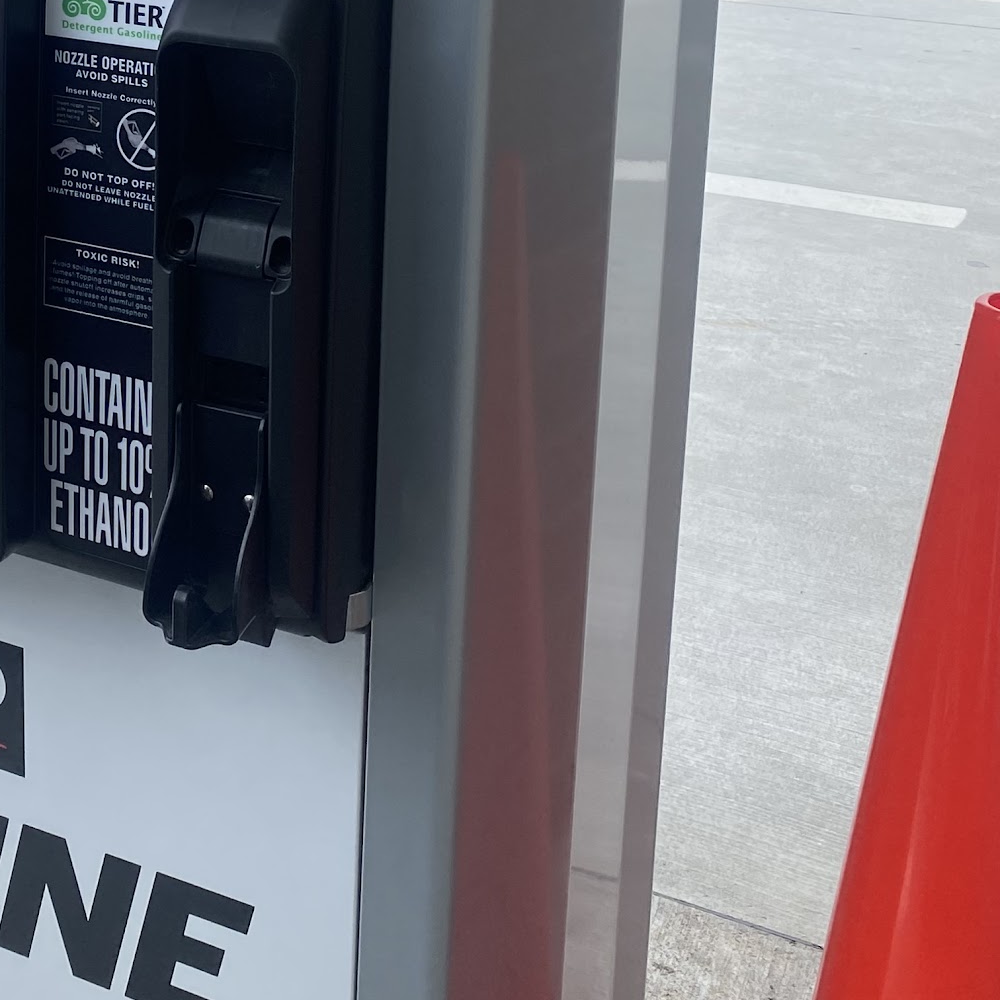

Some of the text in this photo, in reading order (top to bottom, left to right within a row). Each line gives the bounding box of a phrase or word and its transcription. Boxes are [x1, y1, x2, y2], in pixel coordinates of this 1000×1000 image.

[62, 19, 113, 35] Detergent
[54, 49, 98, 69] NOZZLE
[75, 69, 149, 88] AVOID SPILLS
[65, 86, 89, 97] Insert
[91, 90, 118, 101] Nozzle
[64, 167, 155, 191] DO NOT TOP OFF!
[47, 186, 102, 203] UNATTENDED
[103, 195, 131, 208] WHILE
[61, 179, 156, 203] DO NOT LEAVE NOZZLE
[76, 248, 140, 269] TOXIC RISK!
[43, 357, 153, 436] CONTAIN
[43, 417, 74, 475] UP
[79, 426, 109, 486] TO
[50, 478, 150, 558] ETHANO
